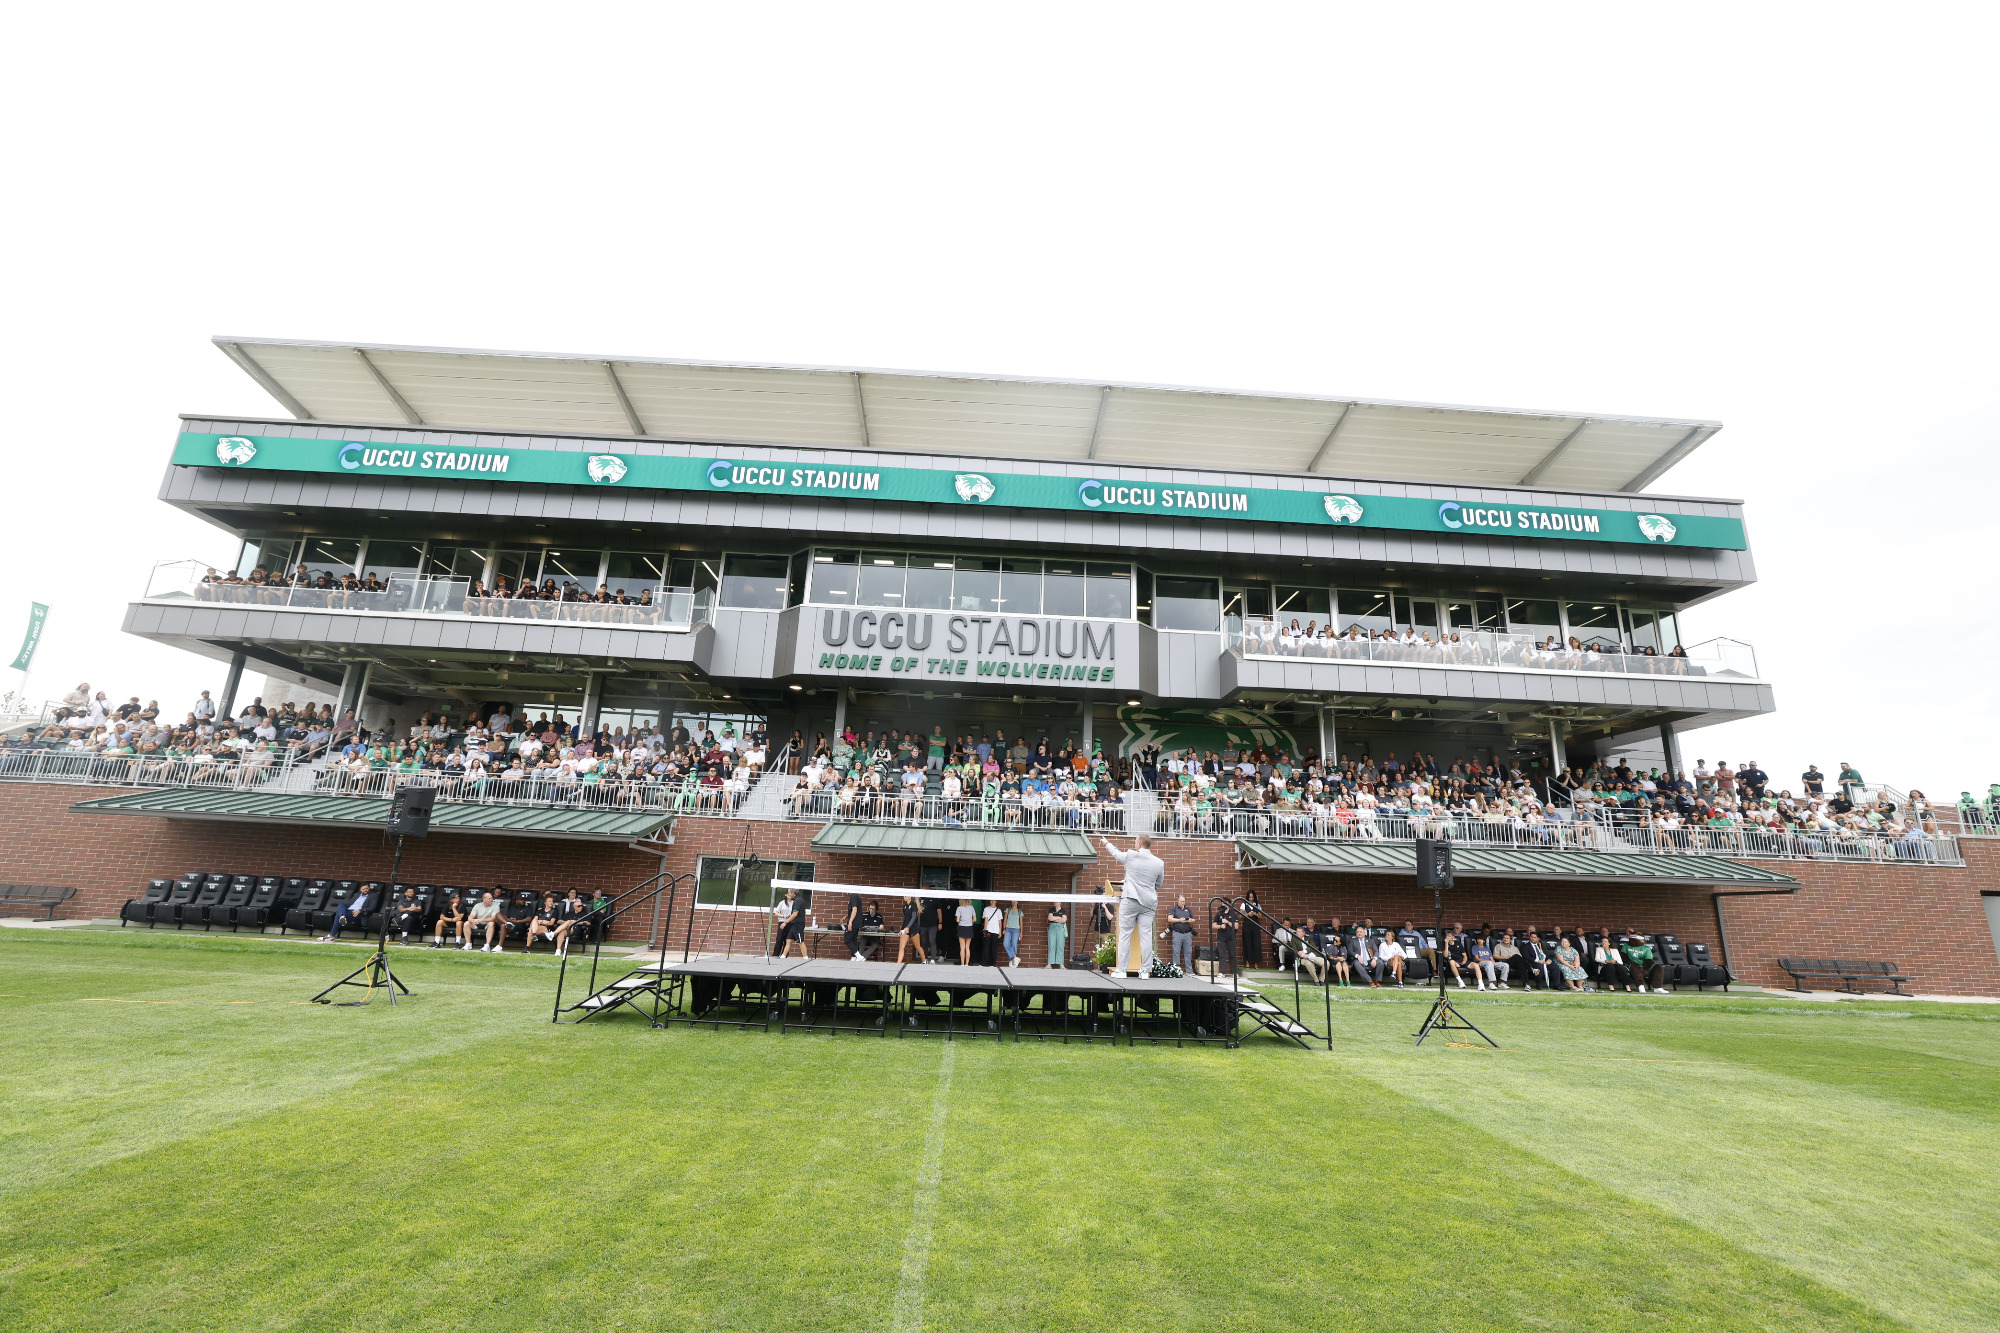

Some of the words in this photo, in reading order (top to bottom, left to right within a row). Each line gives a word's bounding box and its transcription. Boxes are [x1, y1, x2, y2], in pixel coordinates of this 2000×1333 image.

[363, 448, 416, 468] UCCU
[420, 450, 510, 473] STADIUM
[732, 466, 786, 486] UCCU
[790, 469, 880, 491] STADIUM
[1103, 486, 1156, 506] UCCU
[1161, 489, 1248, 512] STADIUM
[1463, 507, 1512, 528] UCCU
[1517, 511, 1600, 533] STADIUM
[32, 621, 40, 639] UTAH
[822, 609, 933, 651] UCCU
[946, 615, 1116, 661] STADIUM
[21, 640, 35, 664] VALLEY
[819, 653, 883, 671] HOME
[890, 657, 919, 672] OF
[928, 658, 969, 675] THE
[977, 661, 1115, 683] WOLVERINES
